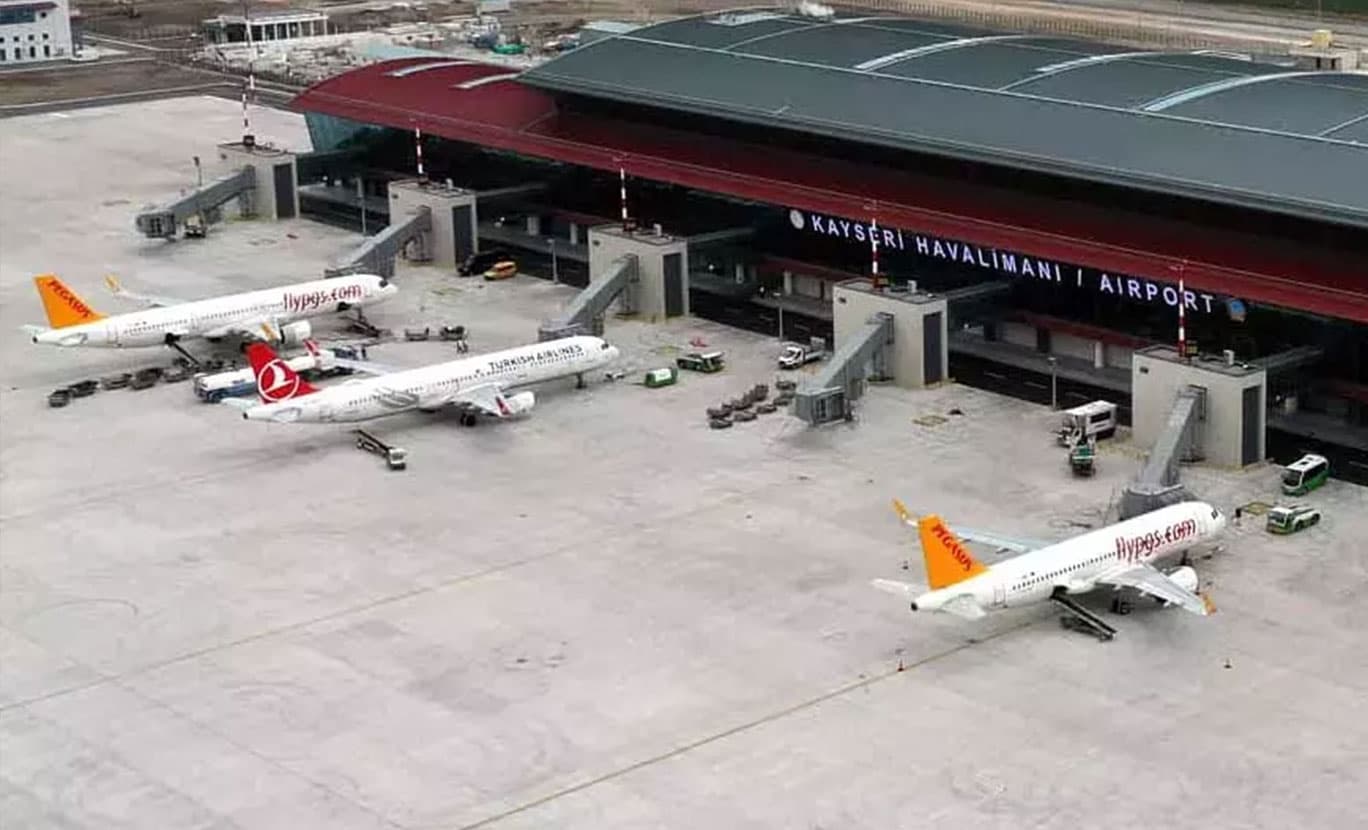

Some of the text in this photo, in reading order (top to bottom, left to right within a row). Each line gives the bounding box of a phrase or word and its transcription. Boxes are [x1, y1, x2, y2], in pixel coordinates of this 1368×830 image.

[811, 215, 904, 250] KAYSERİ
[915, 235, 1061, 282] HAVALİMANI
[1100, 273, 1214, 313] AIRPORT
[488, 344, 583, 371] TURKISH AIRLINES
